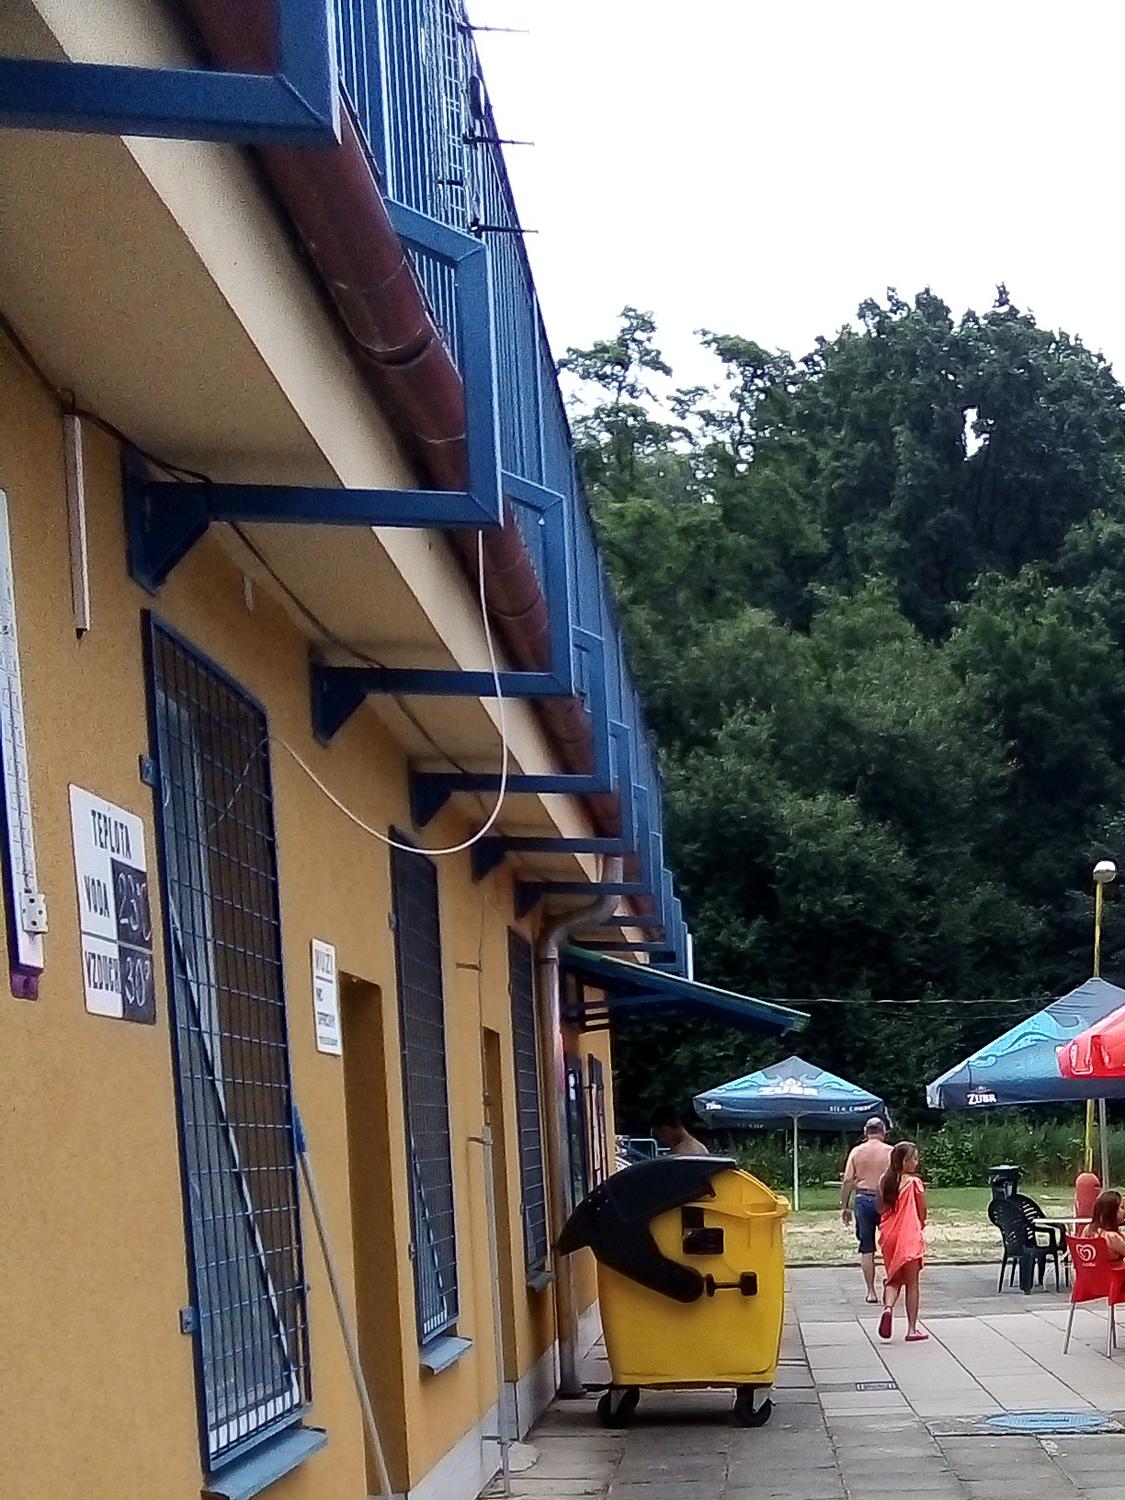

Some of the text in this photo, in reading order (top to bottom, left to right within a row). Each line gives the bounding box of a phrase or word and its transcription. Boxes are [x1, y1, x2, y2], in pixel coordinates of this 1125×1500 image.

[91, 809, 132, 860] TEPLOTA
[84, 875, 110, 918] VODA
[84, 951, 122, 994] VZDUCH
[966, 1094, 998, 1106] ZUBR
